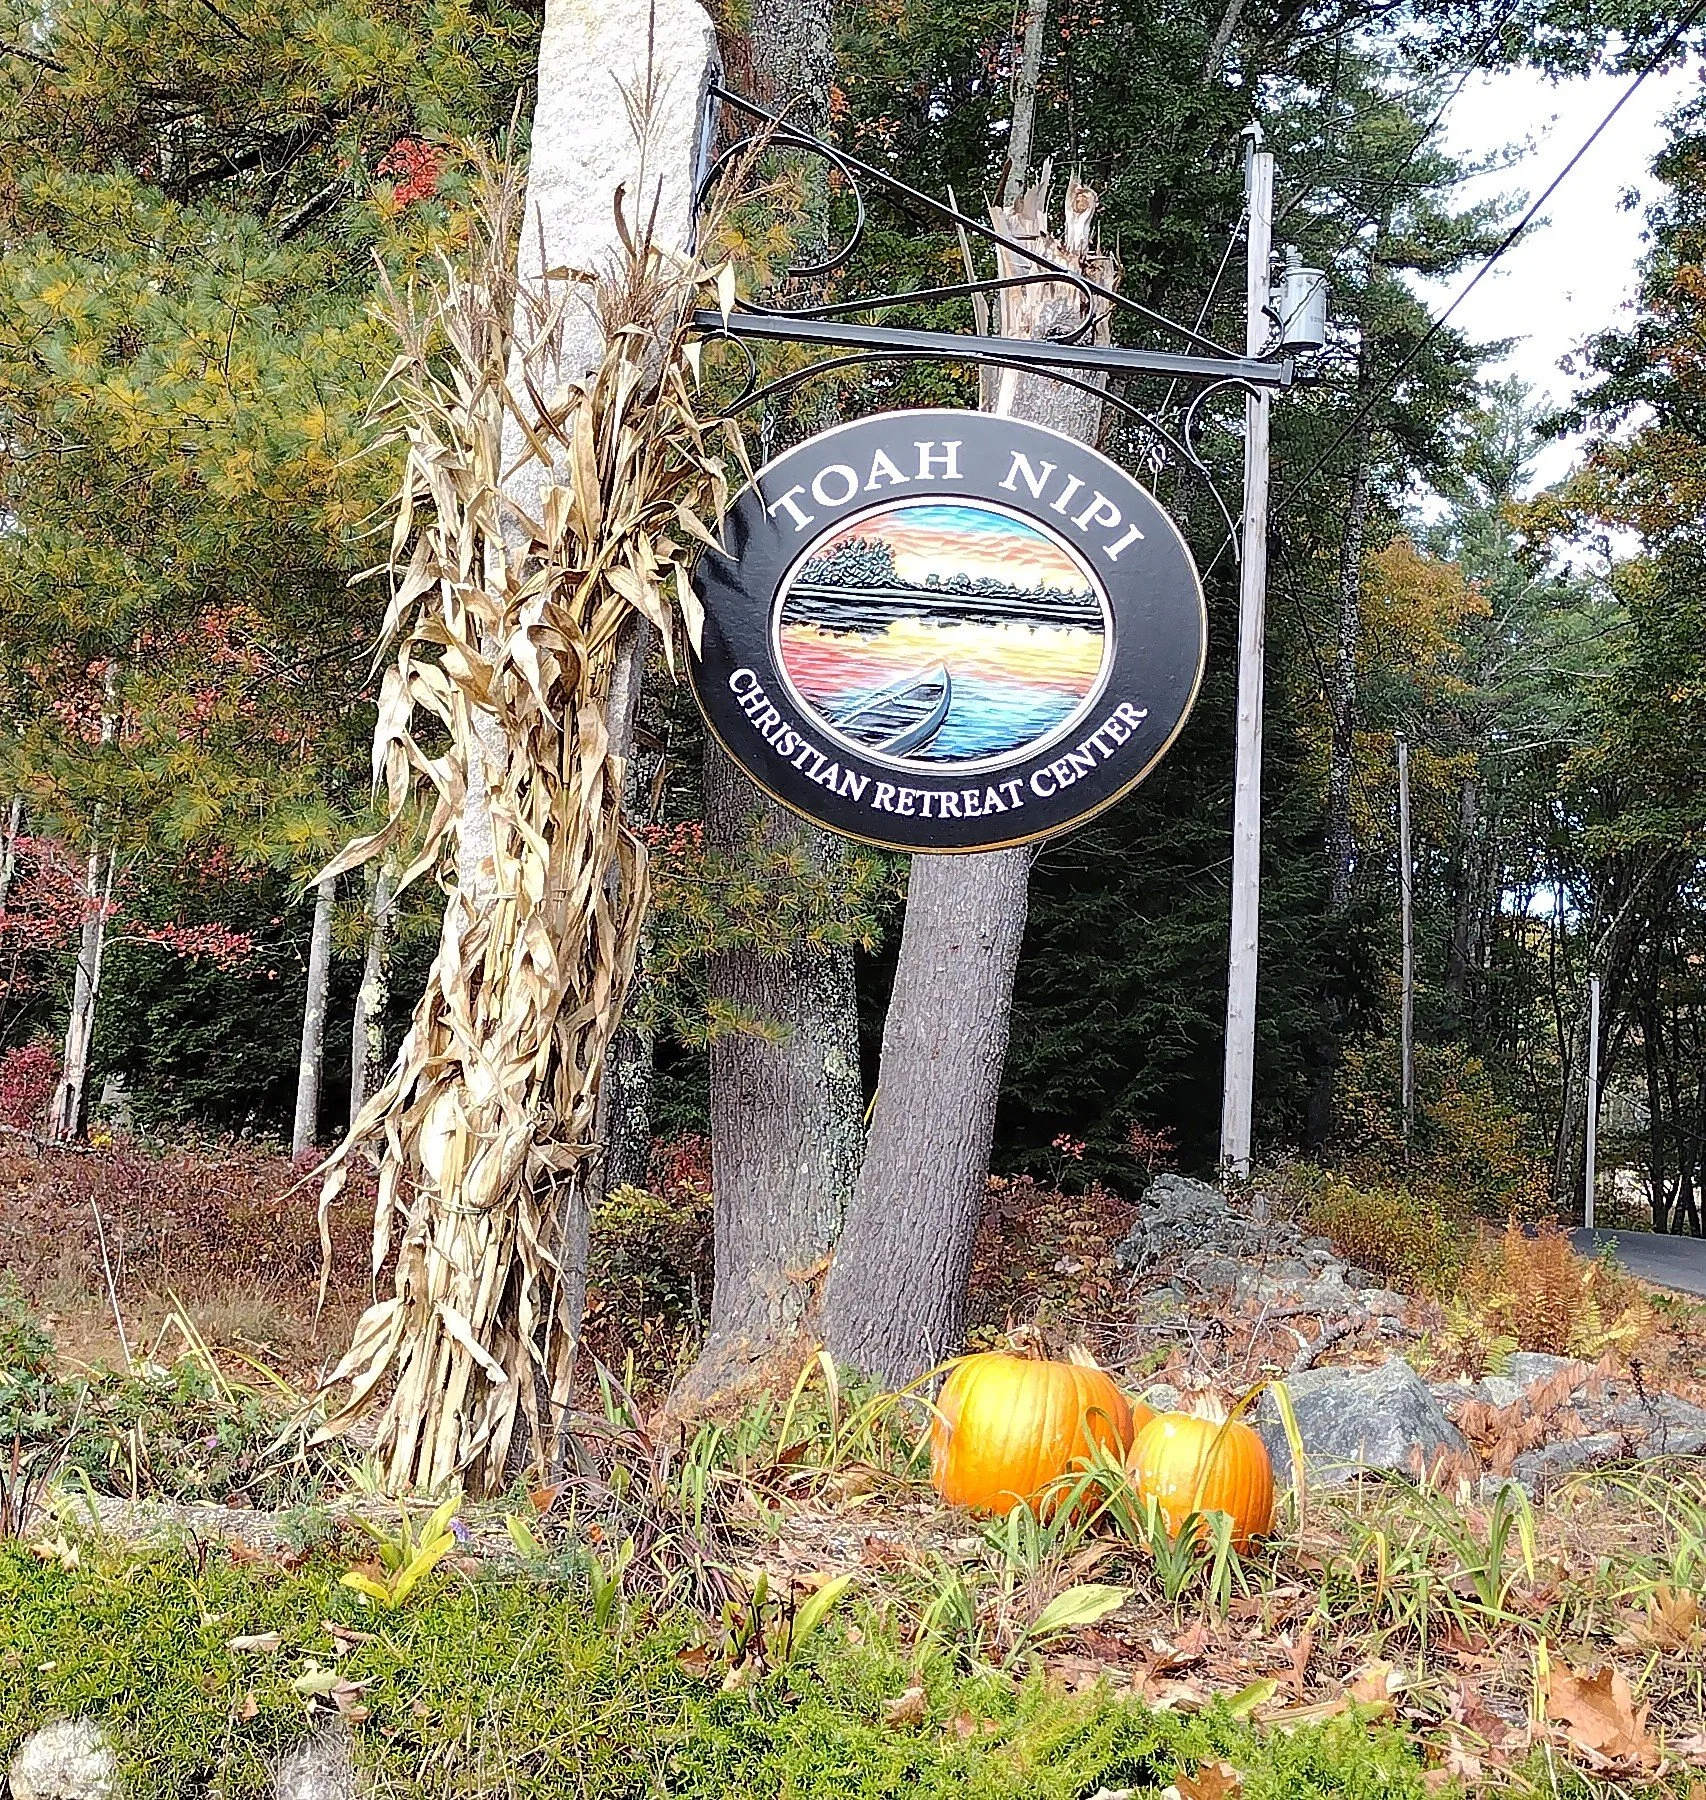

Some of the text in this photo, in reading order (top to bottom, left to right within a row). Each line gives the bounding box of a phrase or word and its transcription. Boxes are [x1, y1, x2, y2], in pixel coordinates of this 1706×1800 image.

[766, 440, 1145, 562] TOAH NIPI
[728, 668, 1148, 818] CHRISTIAN RETREAT CENTER
